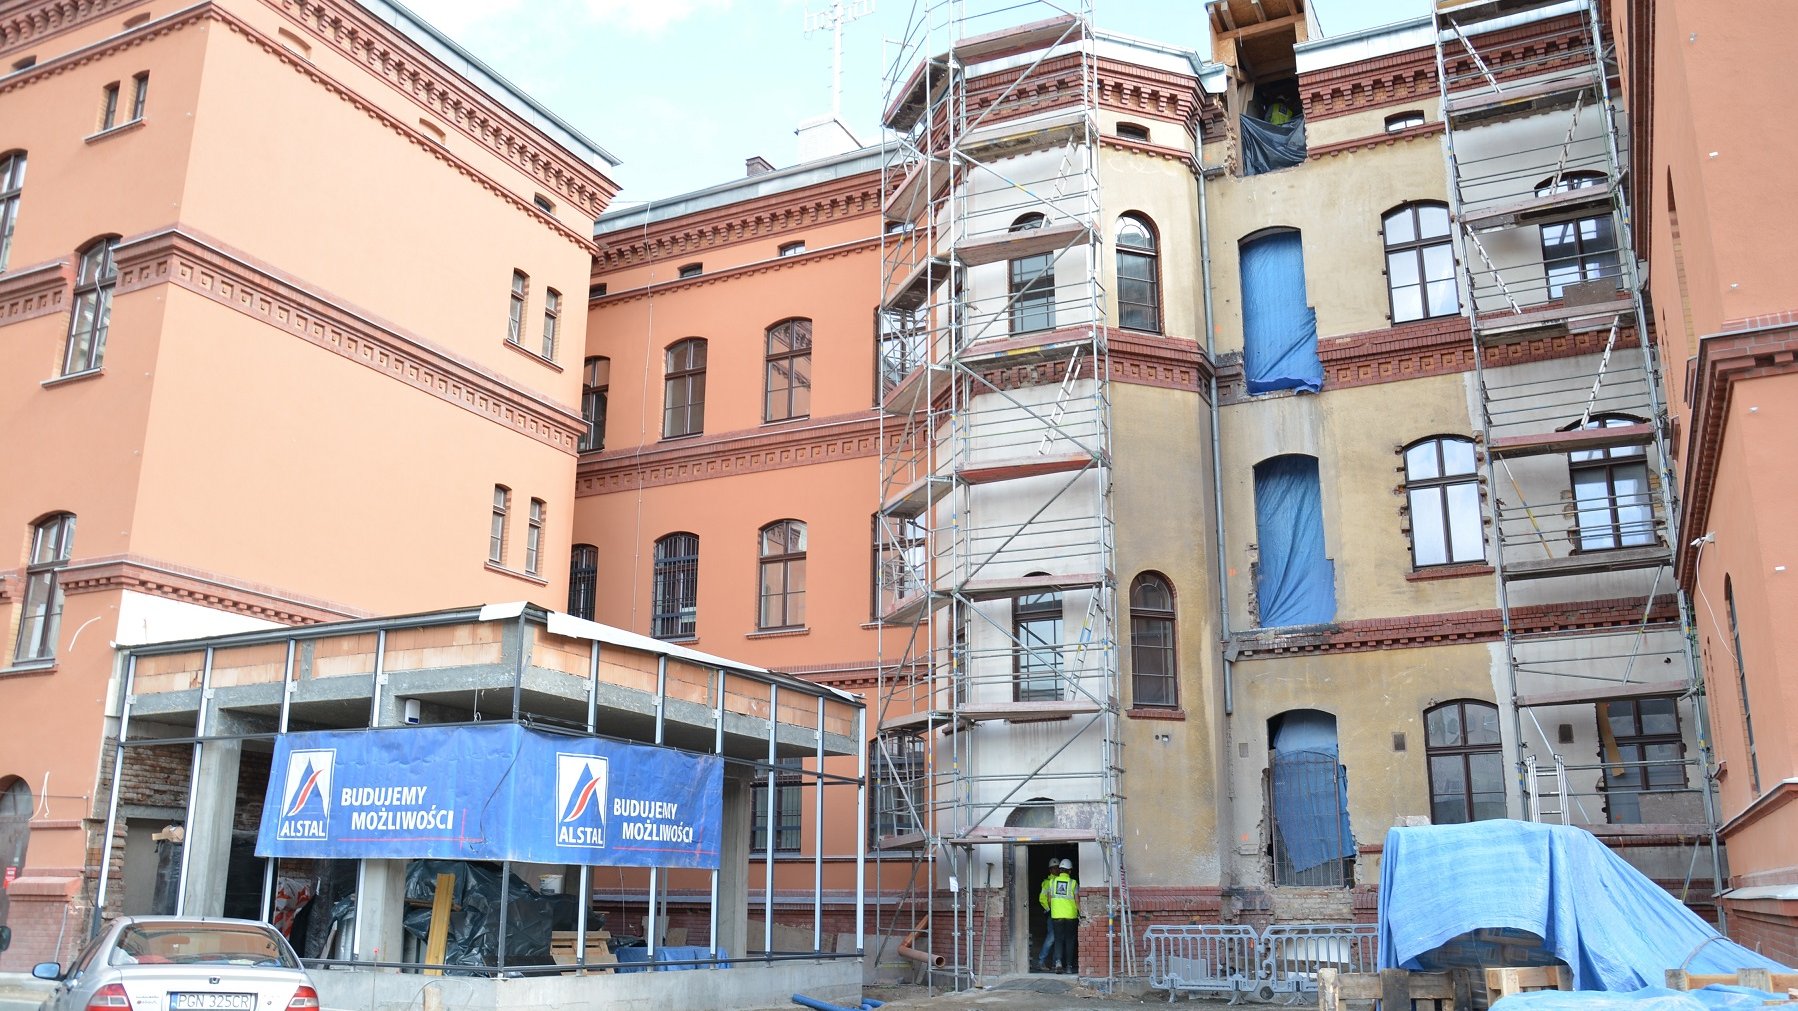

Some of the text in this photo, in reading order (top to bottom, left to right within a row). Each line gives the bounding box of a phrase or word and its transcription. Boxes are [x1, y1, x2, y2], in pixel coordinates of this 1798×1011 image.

[341, 786, 427, 806] BUDUJEMY
[351, 805, 454, 830] MOŻLIWOŚCI
[613, 798, 678, 820] BUDUJEMY
[280, 820, 326, 837] ALSTAL
[558, 826, 603, 844] ALSTAL
[622, 820, 693, 843] MOŻLIWOŚCI
[178, 994, 249, 1008] PGN 325CR
